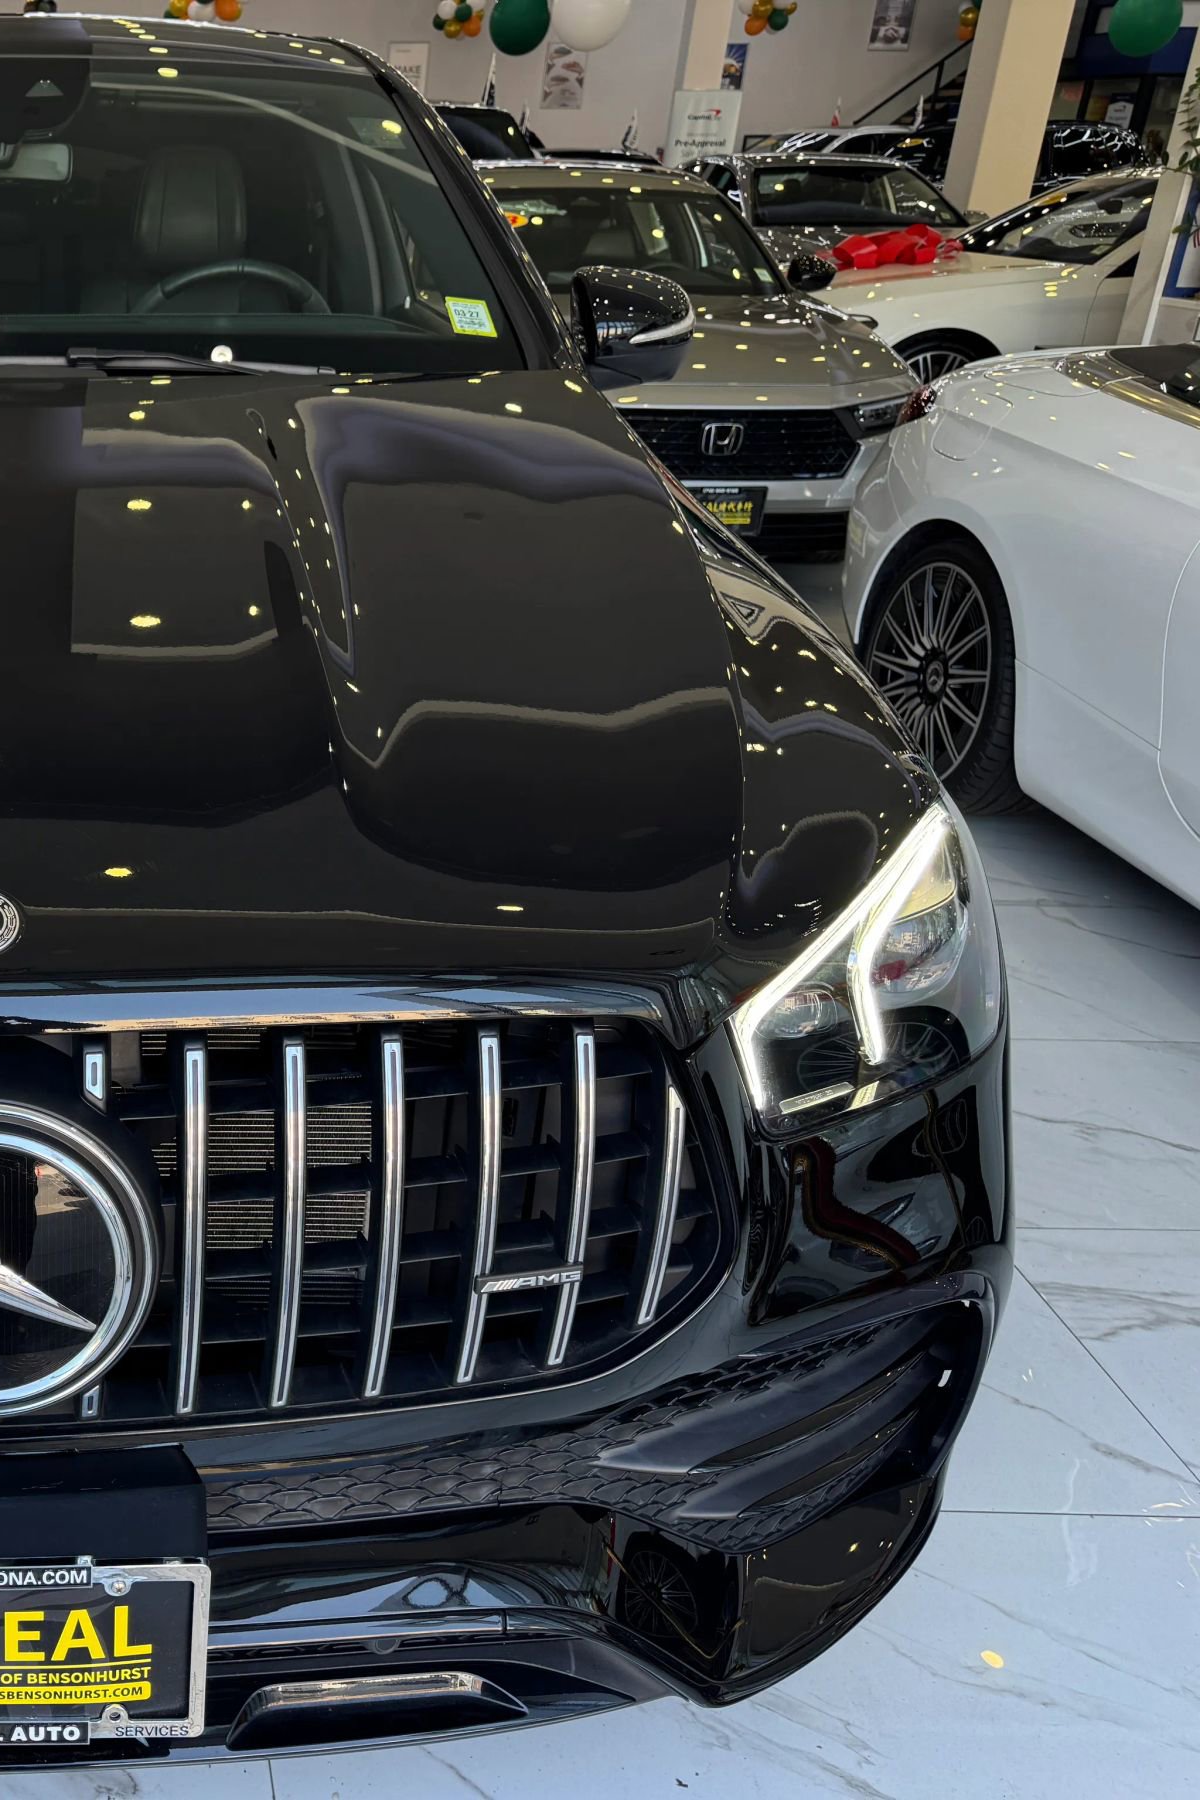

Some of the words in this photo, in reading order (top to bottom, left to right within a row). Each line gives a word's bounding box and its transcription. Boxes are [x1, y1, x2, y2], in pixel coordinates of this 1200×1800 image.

[512, 1270, 581, 1289] AMG
[0, 1673, 23, 1685] OF
[27, 1666, 152, 1684] BENSONHURST
[10, 1725, 81, 1742] AUTO
[115, 1725, 189, 1737] SERVICES
